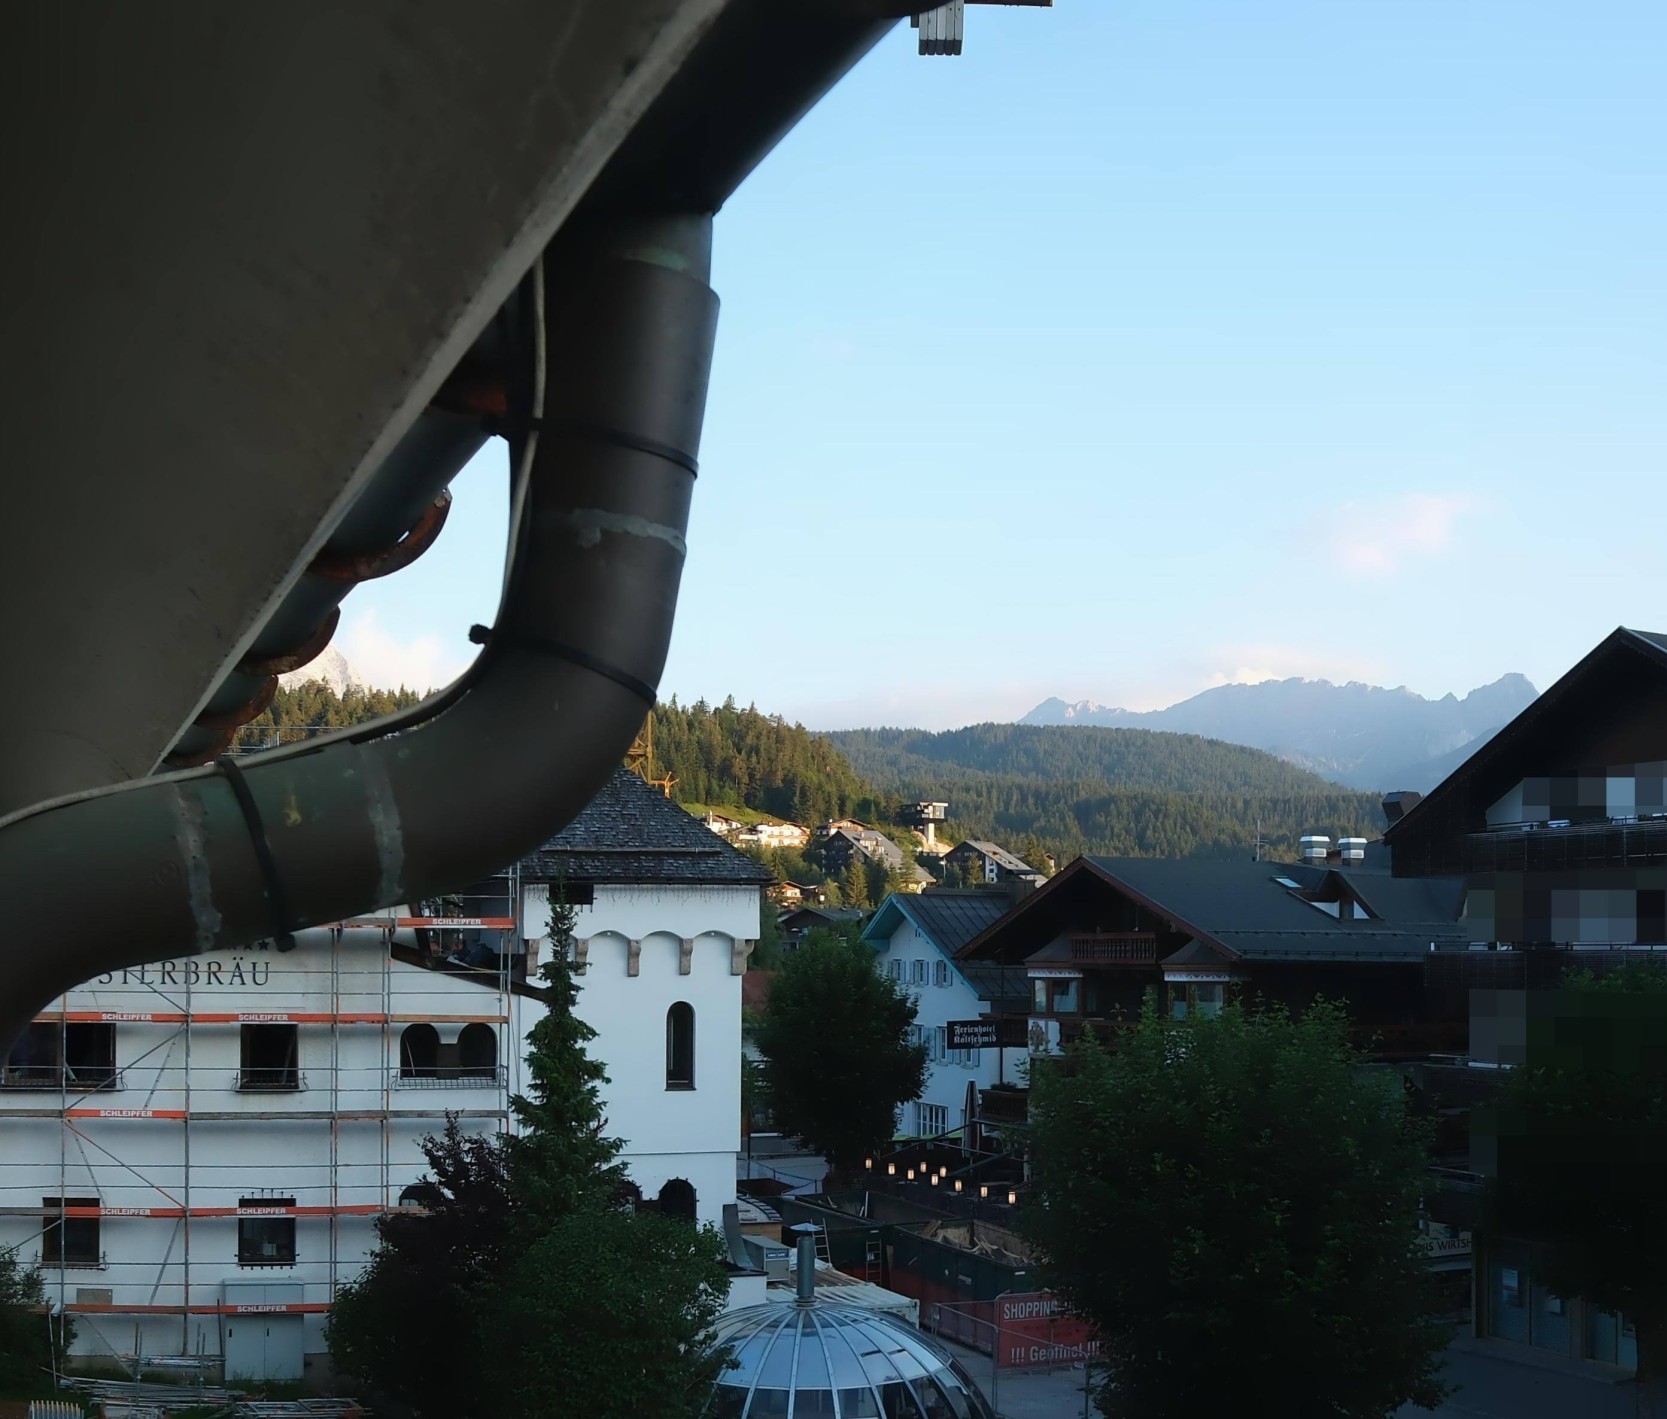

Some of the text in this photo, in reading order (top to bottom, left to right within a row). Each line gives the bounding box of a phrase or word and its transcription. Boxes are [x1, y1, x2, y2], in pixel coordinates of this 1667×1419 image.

[82, 956, 270, 986] STERBRÄU
[102, 1013, 152, 1021] SCHLEIPFER
[954, 1024, 996, 1035] Ferienhotel
[100, 1208, 150, 1216] SCHLEIPFER
